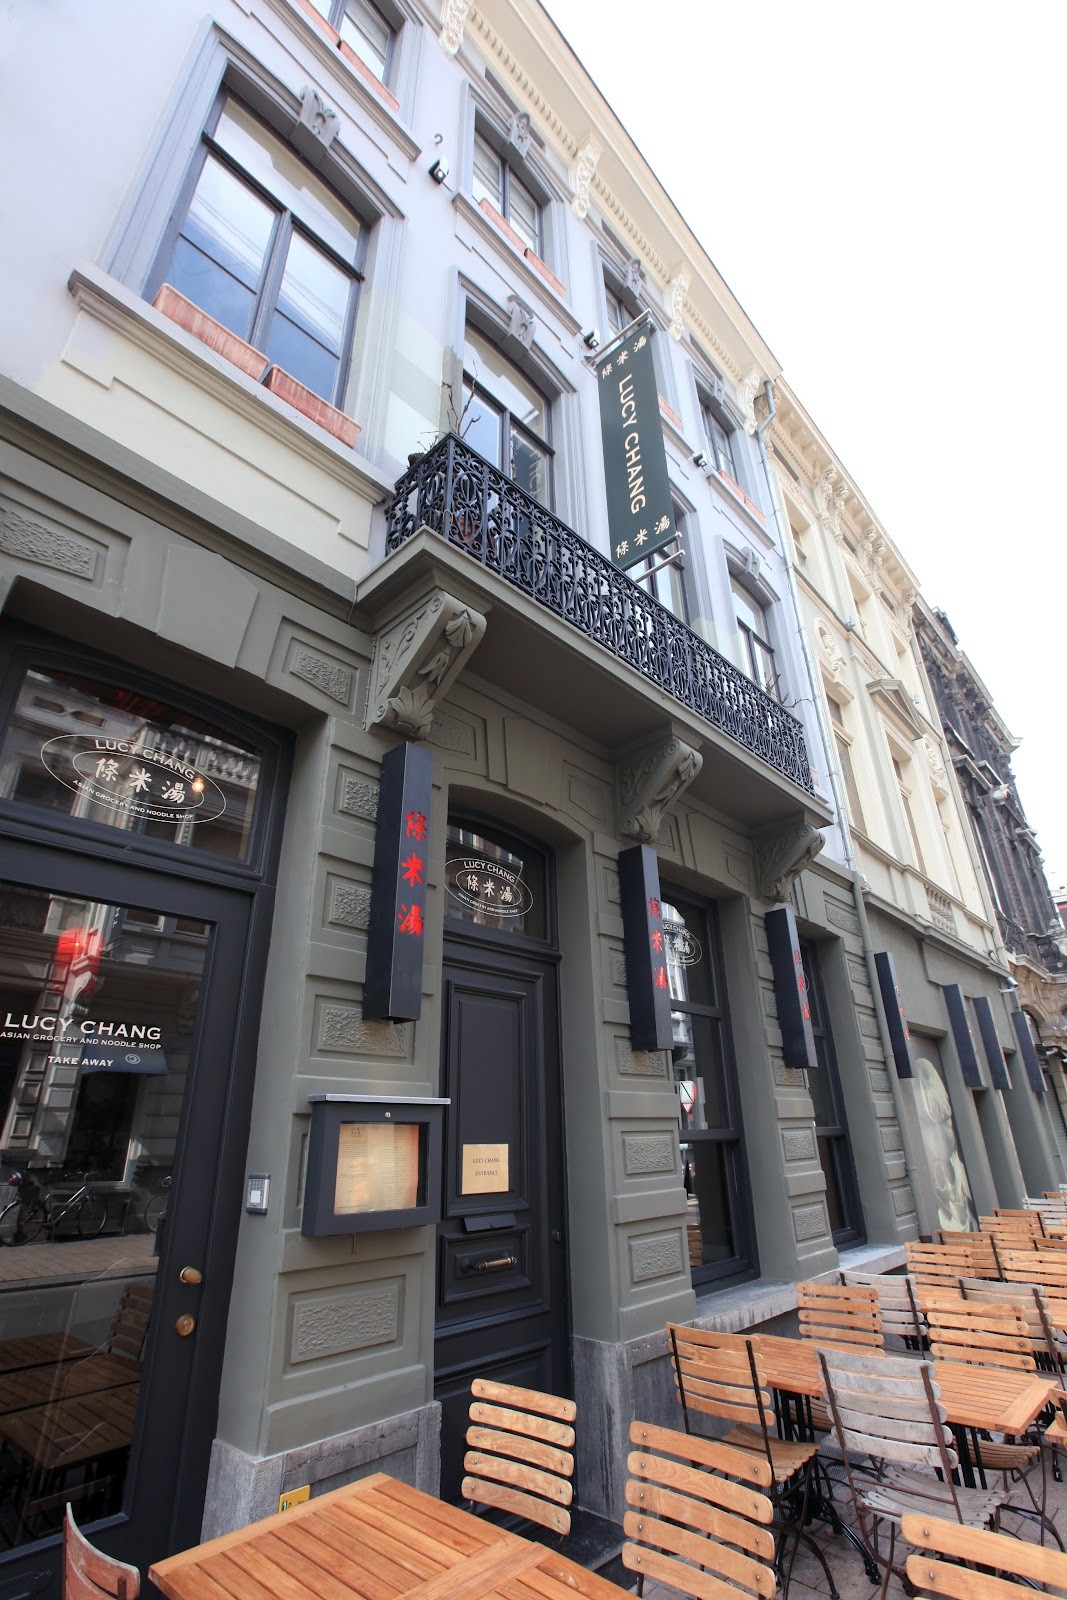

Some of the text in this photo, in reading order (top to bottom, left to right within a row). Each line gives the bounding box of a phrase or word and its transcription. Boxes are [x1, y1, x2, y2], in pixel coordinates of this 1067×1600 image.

[618, 374, 647, 515] LUCY CHANG
[95, 739, 196, 780] LUCY CHANG
[72, 779, 95, 794] ASIAN
[95, 791, 129, 809] GROCERY
[129, 805, 146, 814] AND
[146, 809, 175, 819] NOODLE
[463, 860, 515, 884] LUCY CHANG
[0, 1031, 162, 1050] ASIAN GROCERY AND NOODLE SHOP
[4, 1012, 162, 1041] LUCY CHANG
[47, 1055, 114, 1067] TAKE AWAY
